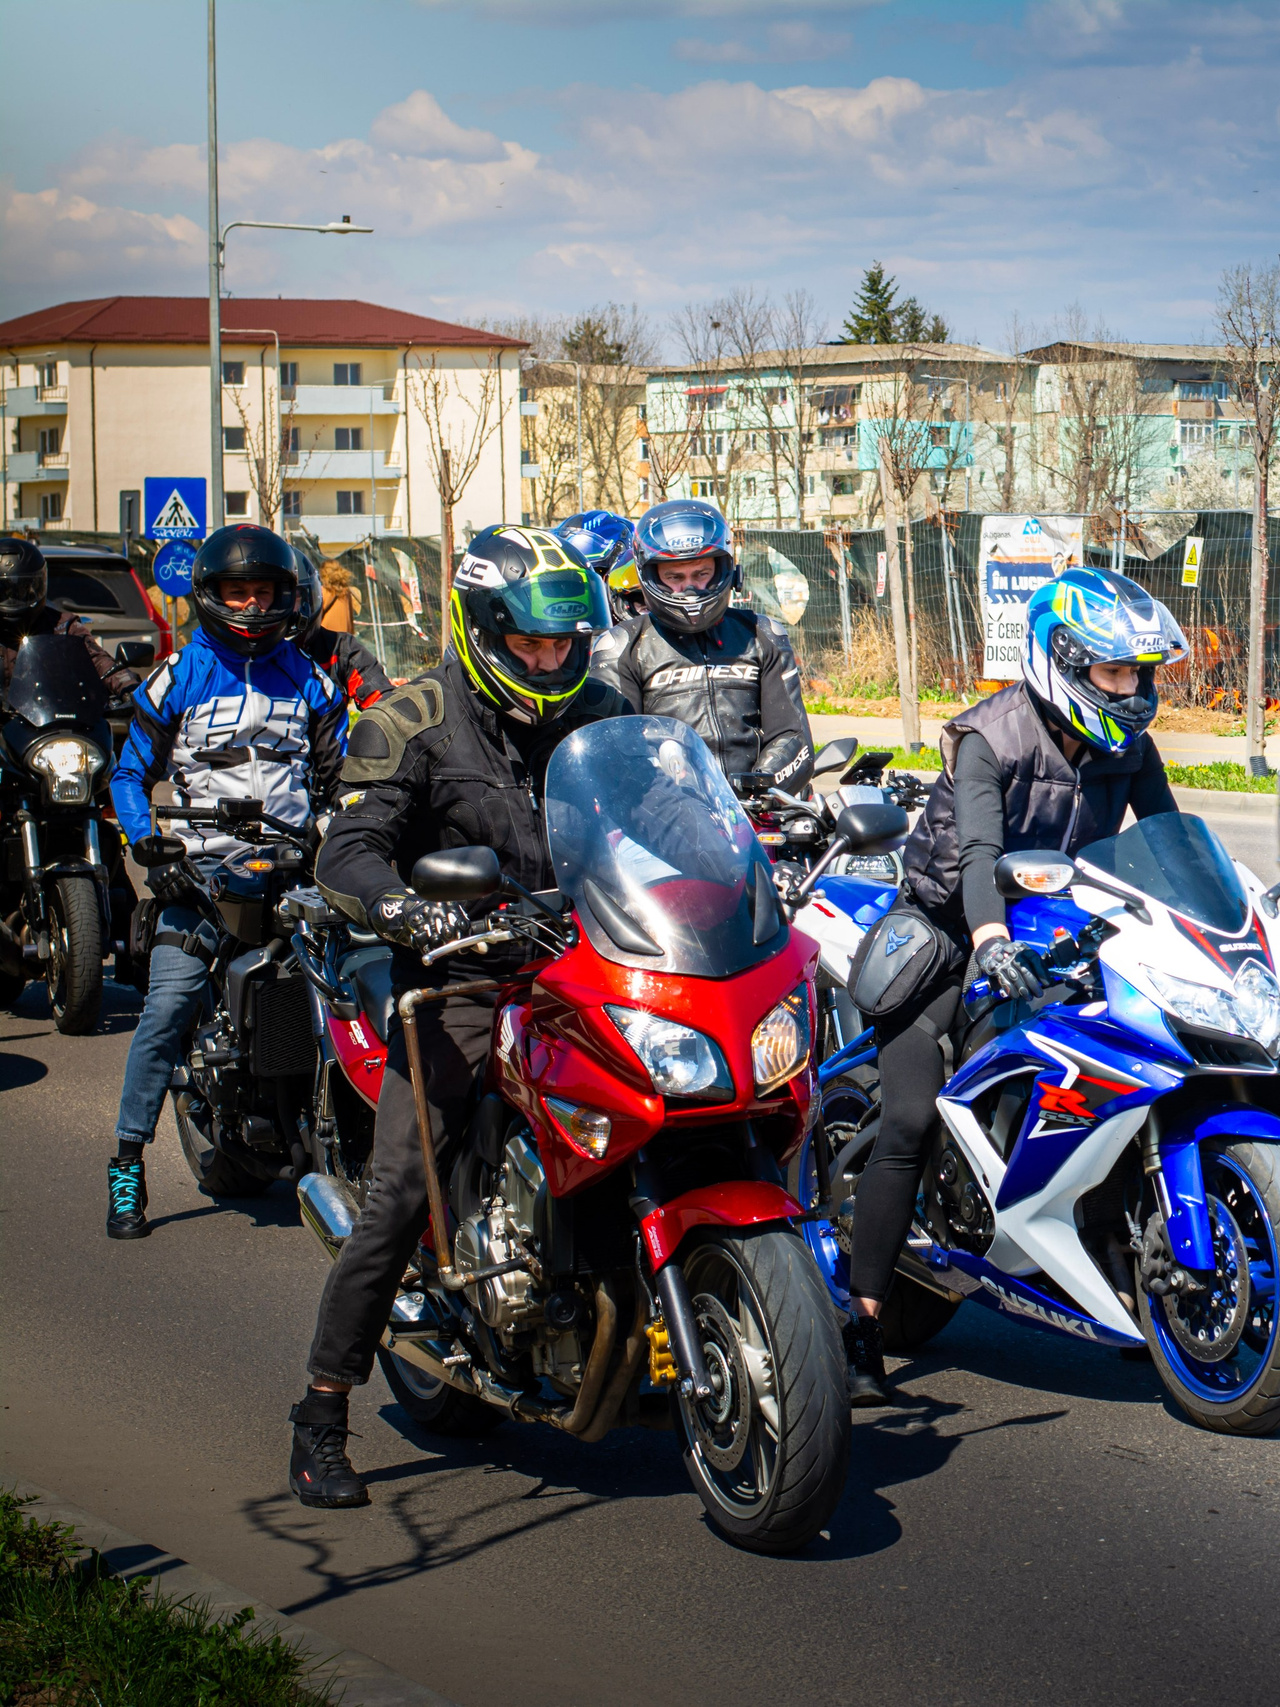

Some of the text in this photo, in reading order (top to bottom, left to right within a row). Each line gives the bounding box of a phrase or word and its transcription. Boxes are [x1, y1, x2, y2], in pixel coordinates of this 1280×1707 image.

[992, 570, 1009, 590] ÎN
[551, 603, 583, 614] HJC
[1135, 637, 1163, 647] HJC
[650, 664, 760, 688] DAINESE
[774, 745, 810, 785] DAINESE
[1219, 942, 1262, 952] SUZUKI
[1036, 1081, 1097, 1118] R
[1038, 1109, 1096, 1127] GSX
[980, 1275, 1098, 1340] SUZUKI
